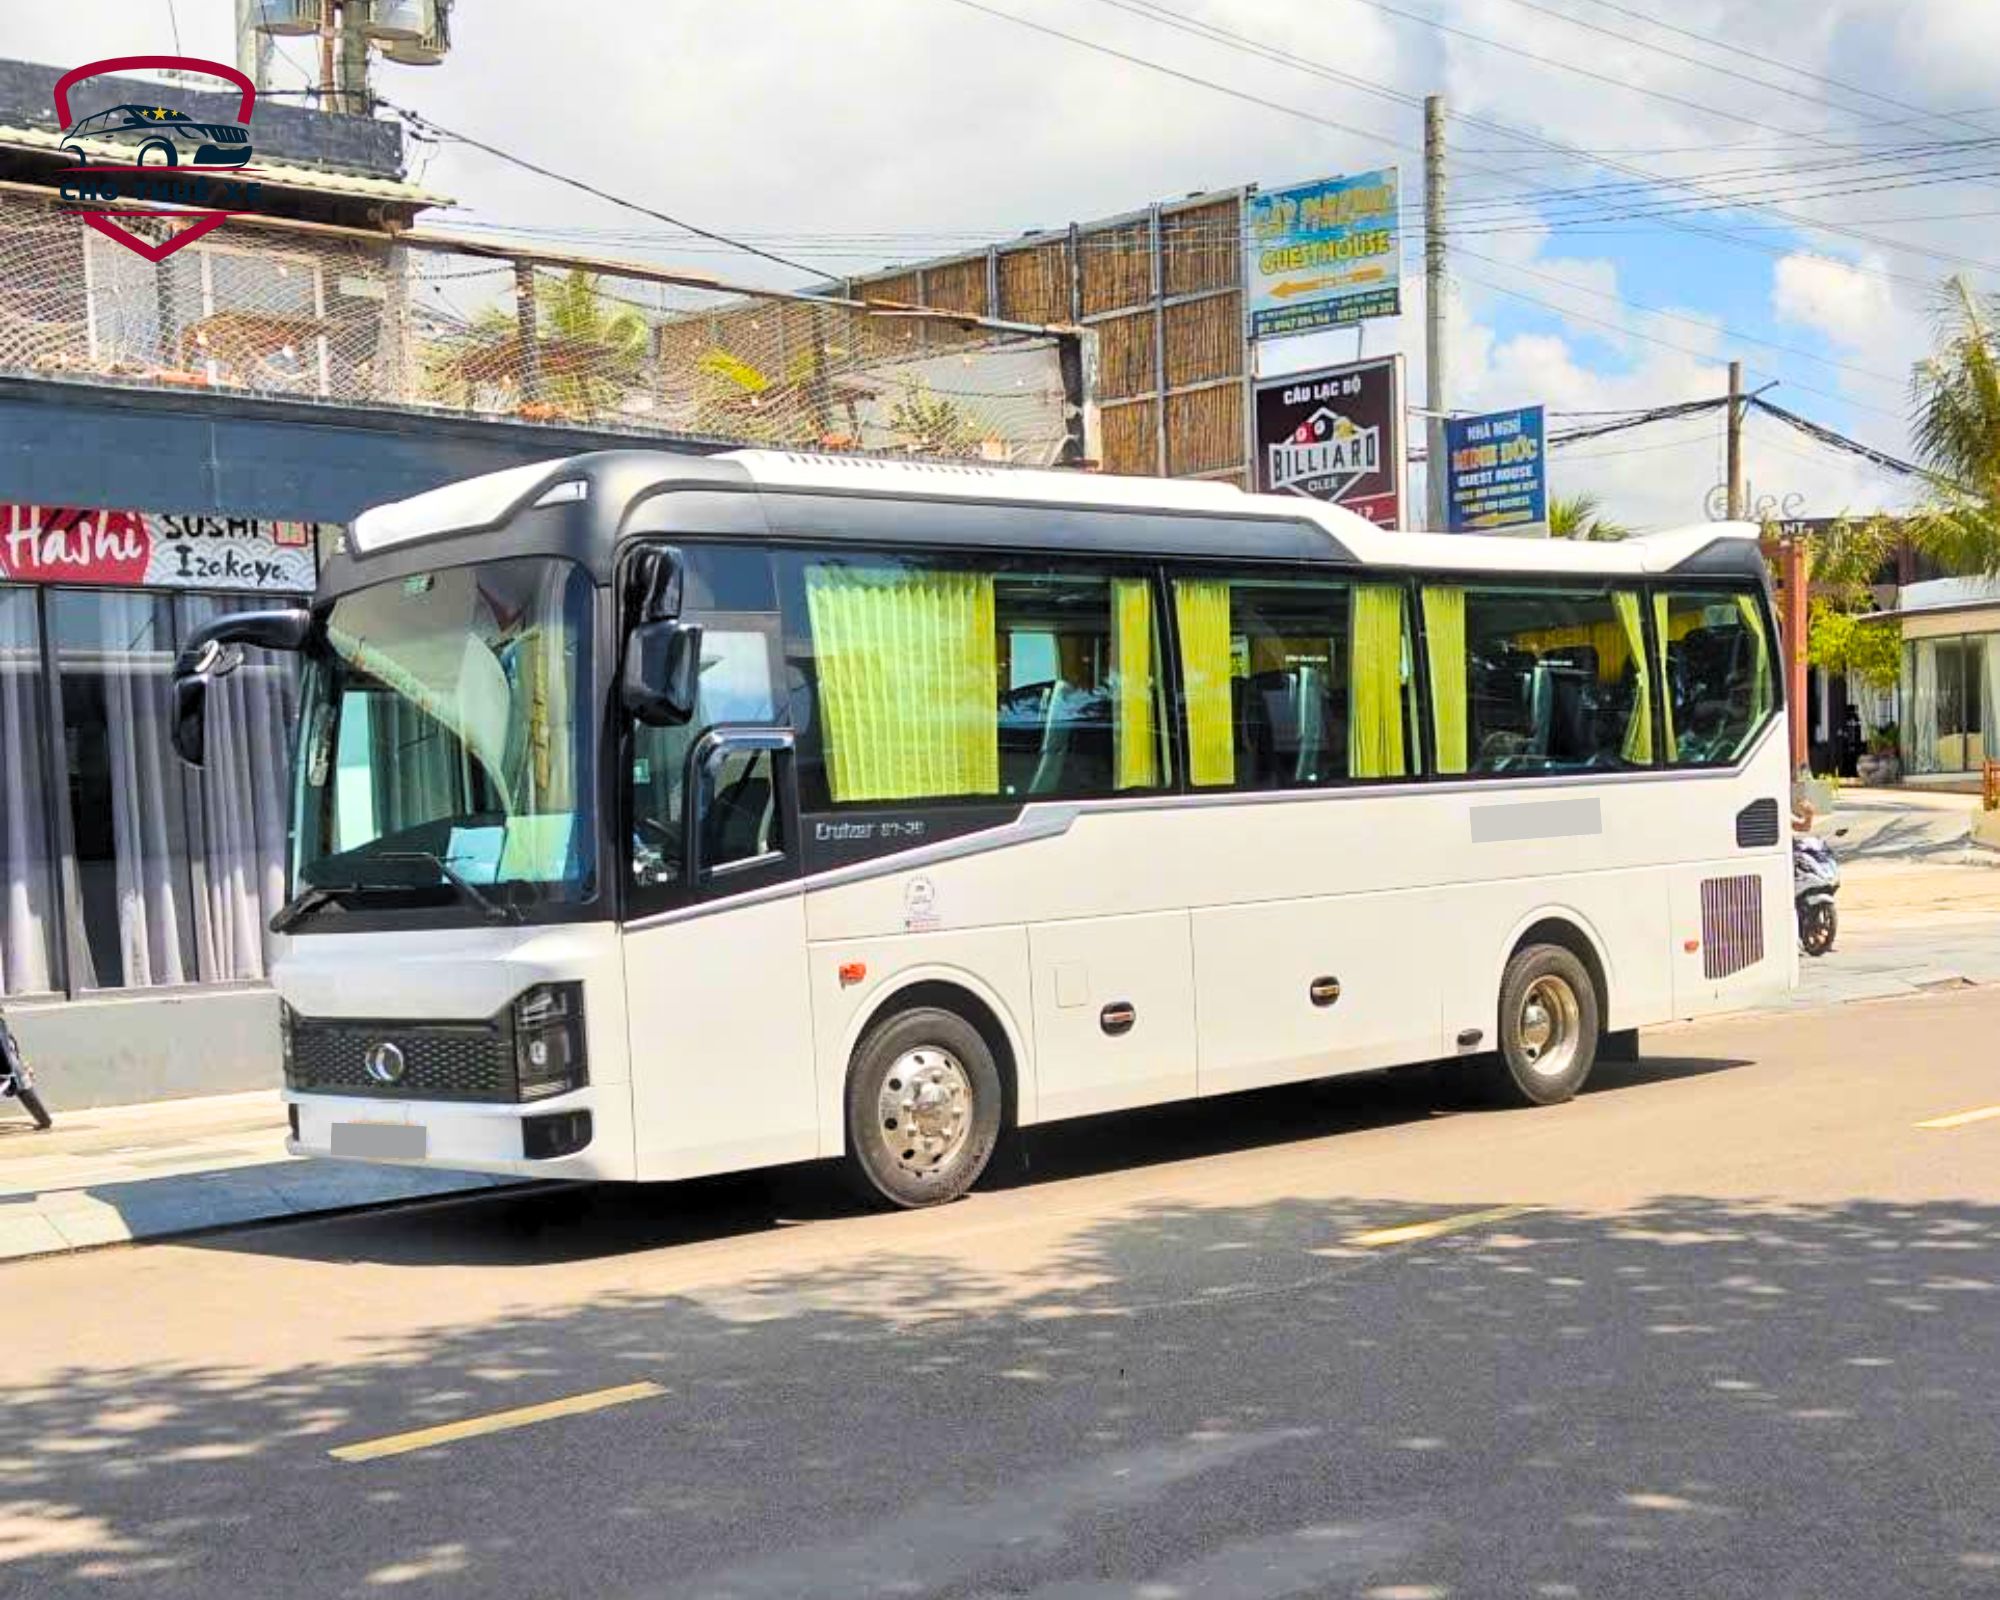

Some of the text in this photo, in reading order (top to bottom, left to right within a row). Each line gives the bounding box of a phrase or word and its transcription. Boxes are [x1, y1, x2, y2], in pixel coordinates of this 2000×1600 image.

[1283, 374, 1361, 405] CÂU LẠC BỘ
[1273, 432, 1376, 483] BILLIARD
[1458, 465, 1533, 487] GUEST HOUSE
[5, 505, 143, 568] Hashi
[163, 515, 259, 539] SUSHI
